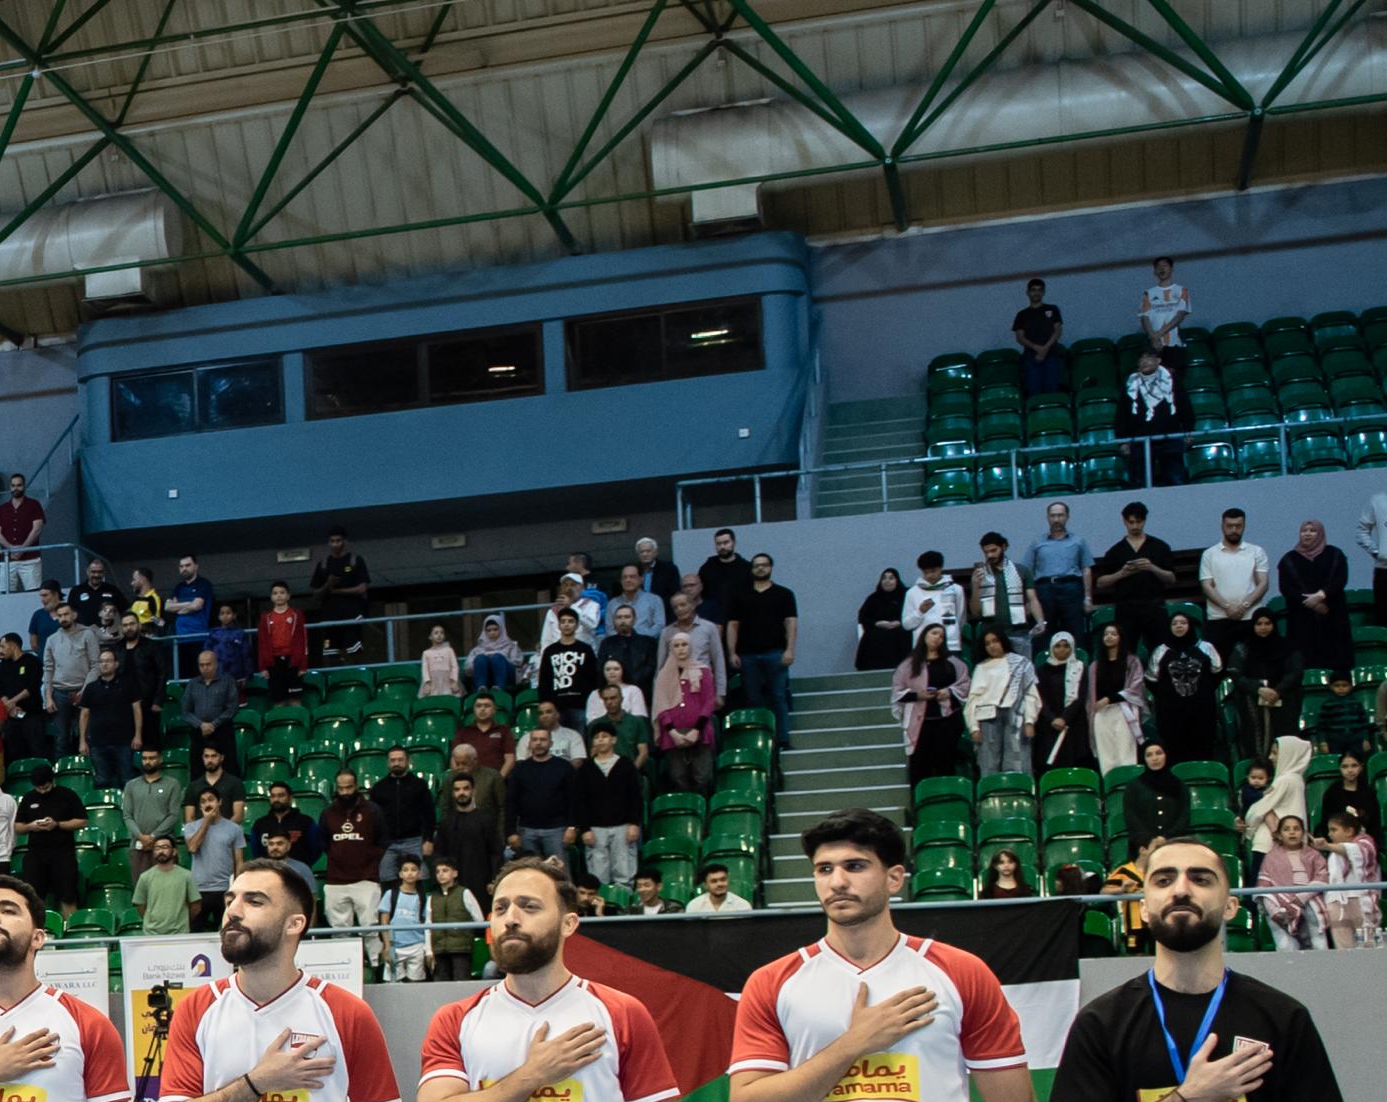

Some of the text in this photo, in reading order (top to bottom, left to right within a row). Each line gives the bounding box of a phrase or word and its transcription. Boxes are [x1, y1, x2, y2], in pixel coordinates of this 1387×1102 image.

[550, 651, 586, 666] RICH
[553, 675, 573, 691] ND
[333, 832, 364, 842] OPEL
[143, 971, 186, 980] Bank Nizwa
